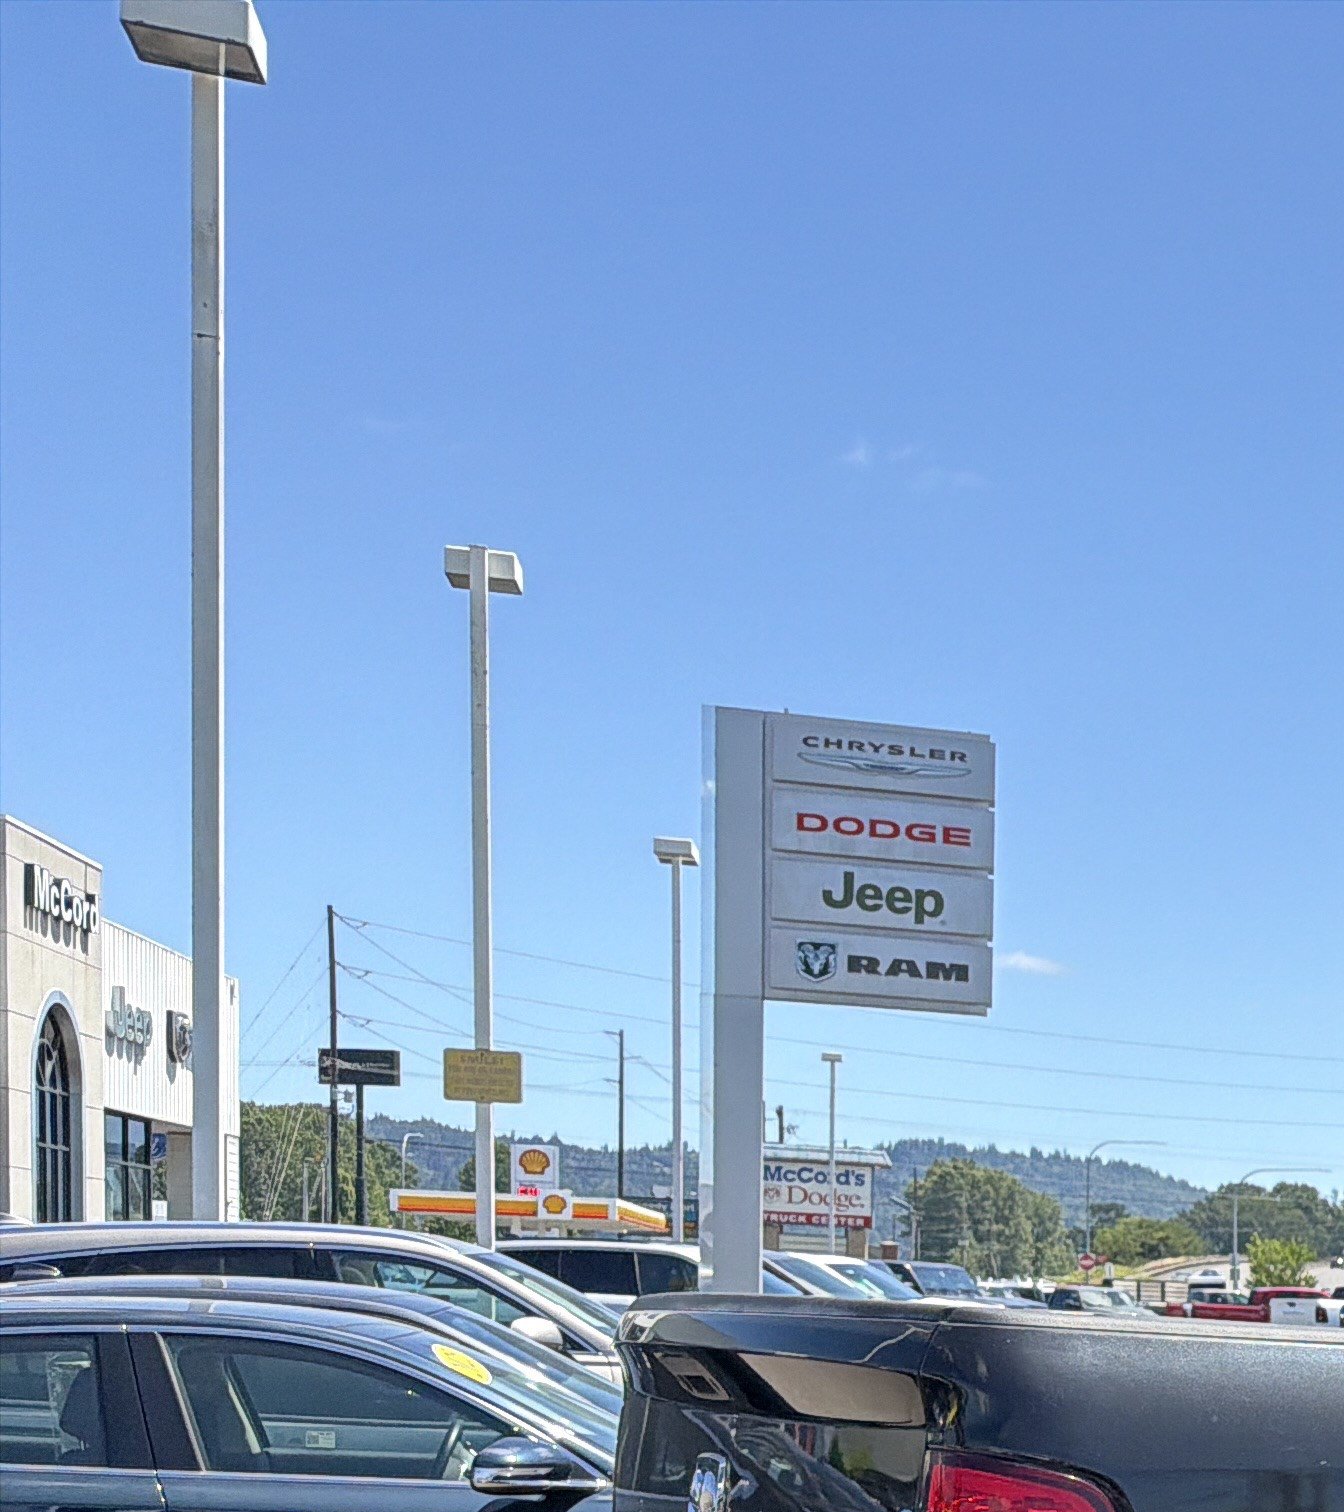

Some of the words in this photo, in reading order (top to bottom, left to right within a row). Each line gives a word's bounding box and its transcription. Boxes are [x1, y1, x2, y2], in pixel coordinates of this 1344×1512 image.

[802, 735, 968, 763] CHRYSLER
[796, 811, 972, 847] DODGE
[25, 863, 99, 935] McCord
[821, 870, 945, 925] Jeep
[847, 953, 969, 983] RAM
[105, 985, 153, 1050] Jeep
[811, 1215, 865, 1228] CETER
